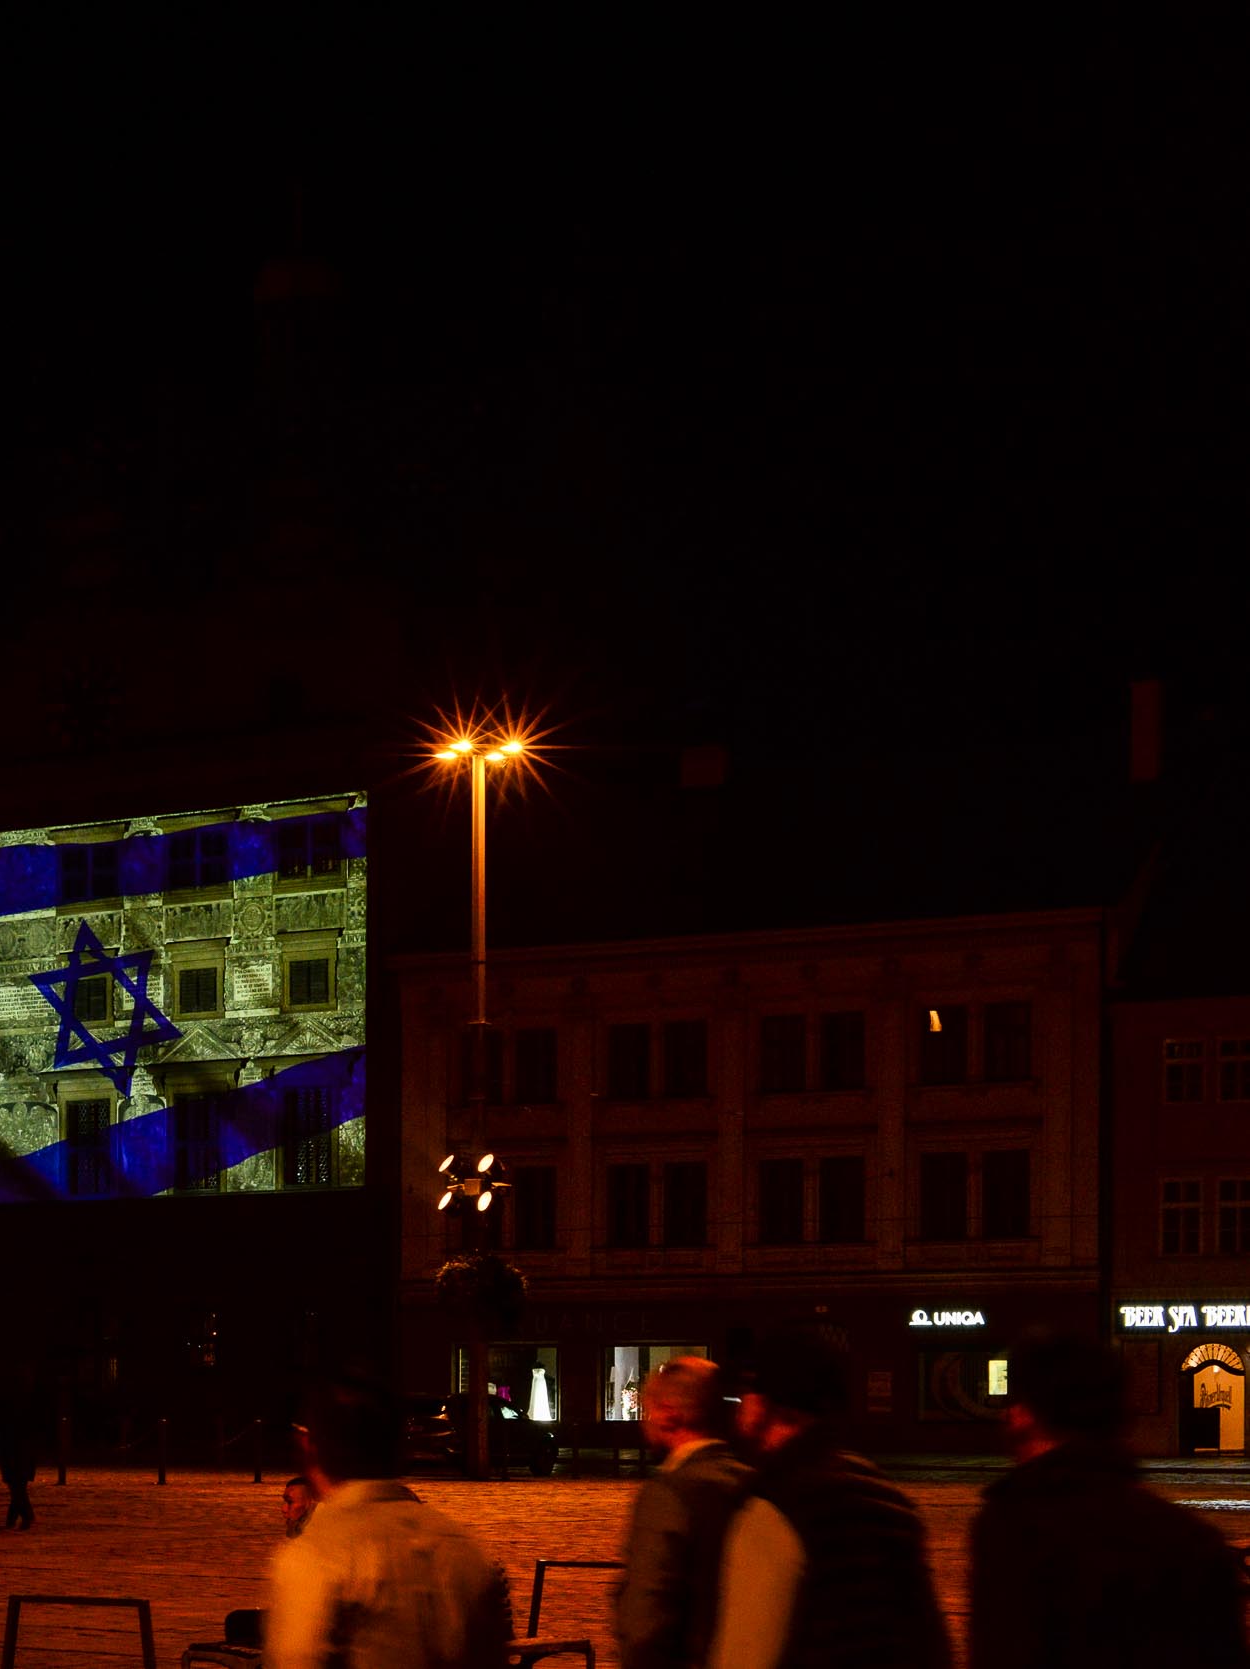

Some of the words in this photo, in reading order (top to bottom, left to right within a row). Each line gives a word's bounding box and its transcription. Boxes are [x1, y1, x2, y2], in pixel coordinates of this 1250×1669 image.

[934, 1311, 985, 1325] UNIQA
[1119, 1306, 1165, 1326] BEER
[1168, 1305, 1197, 1332] SPA
